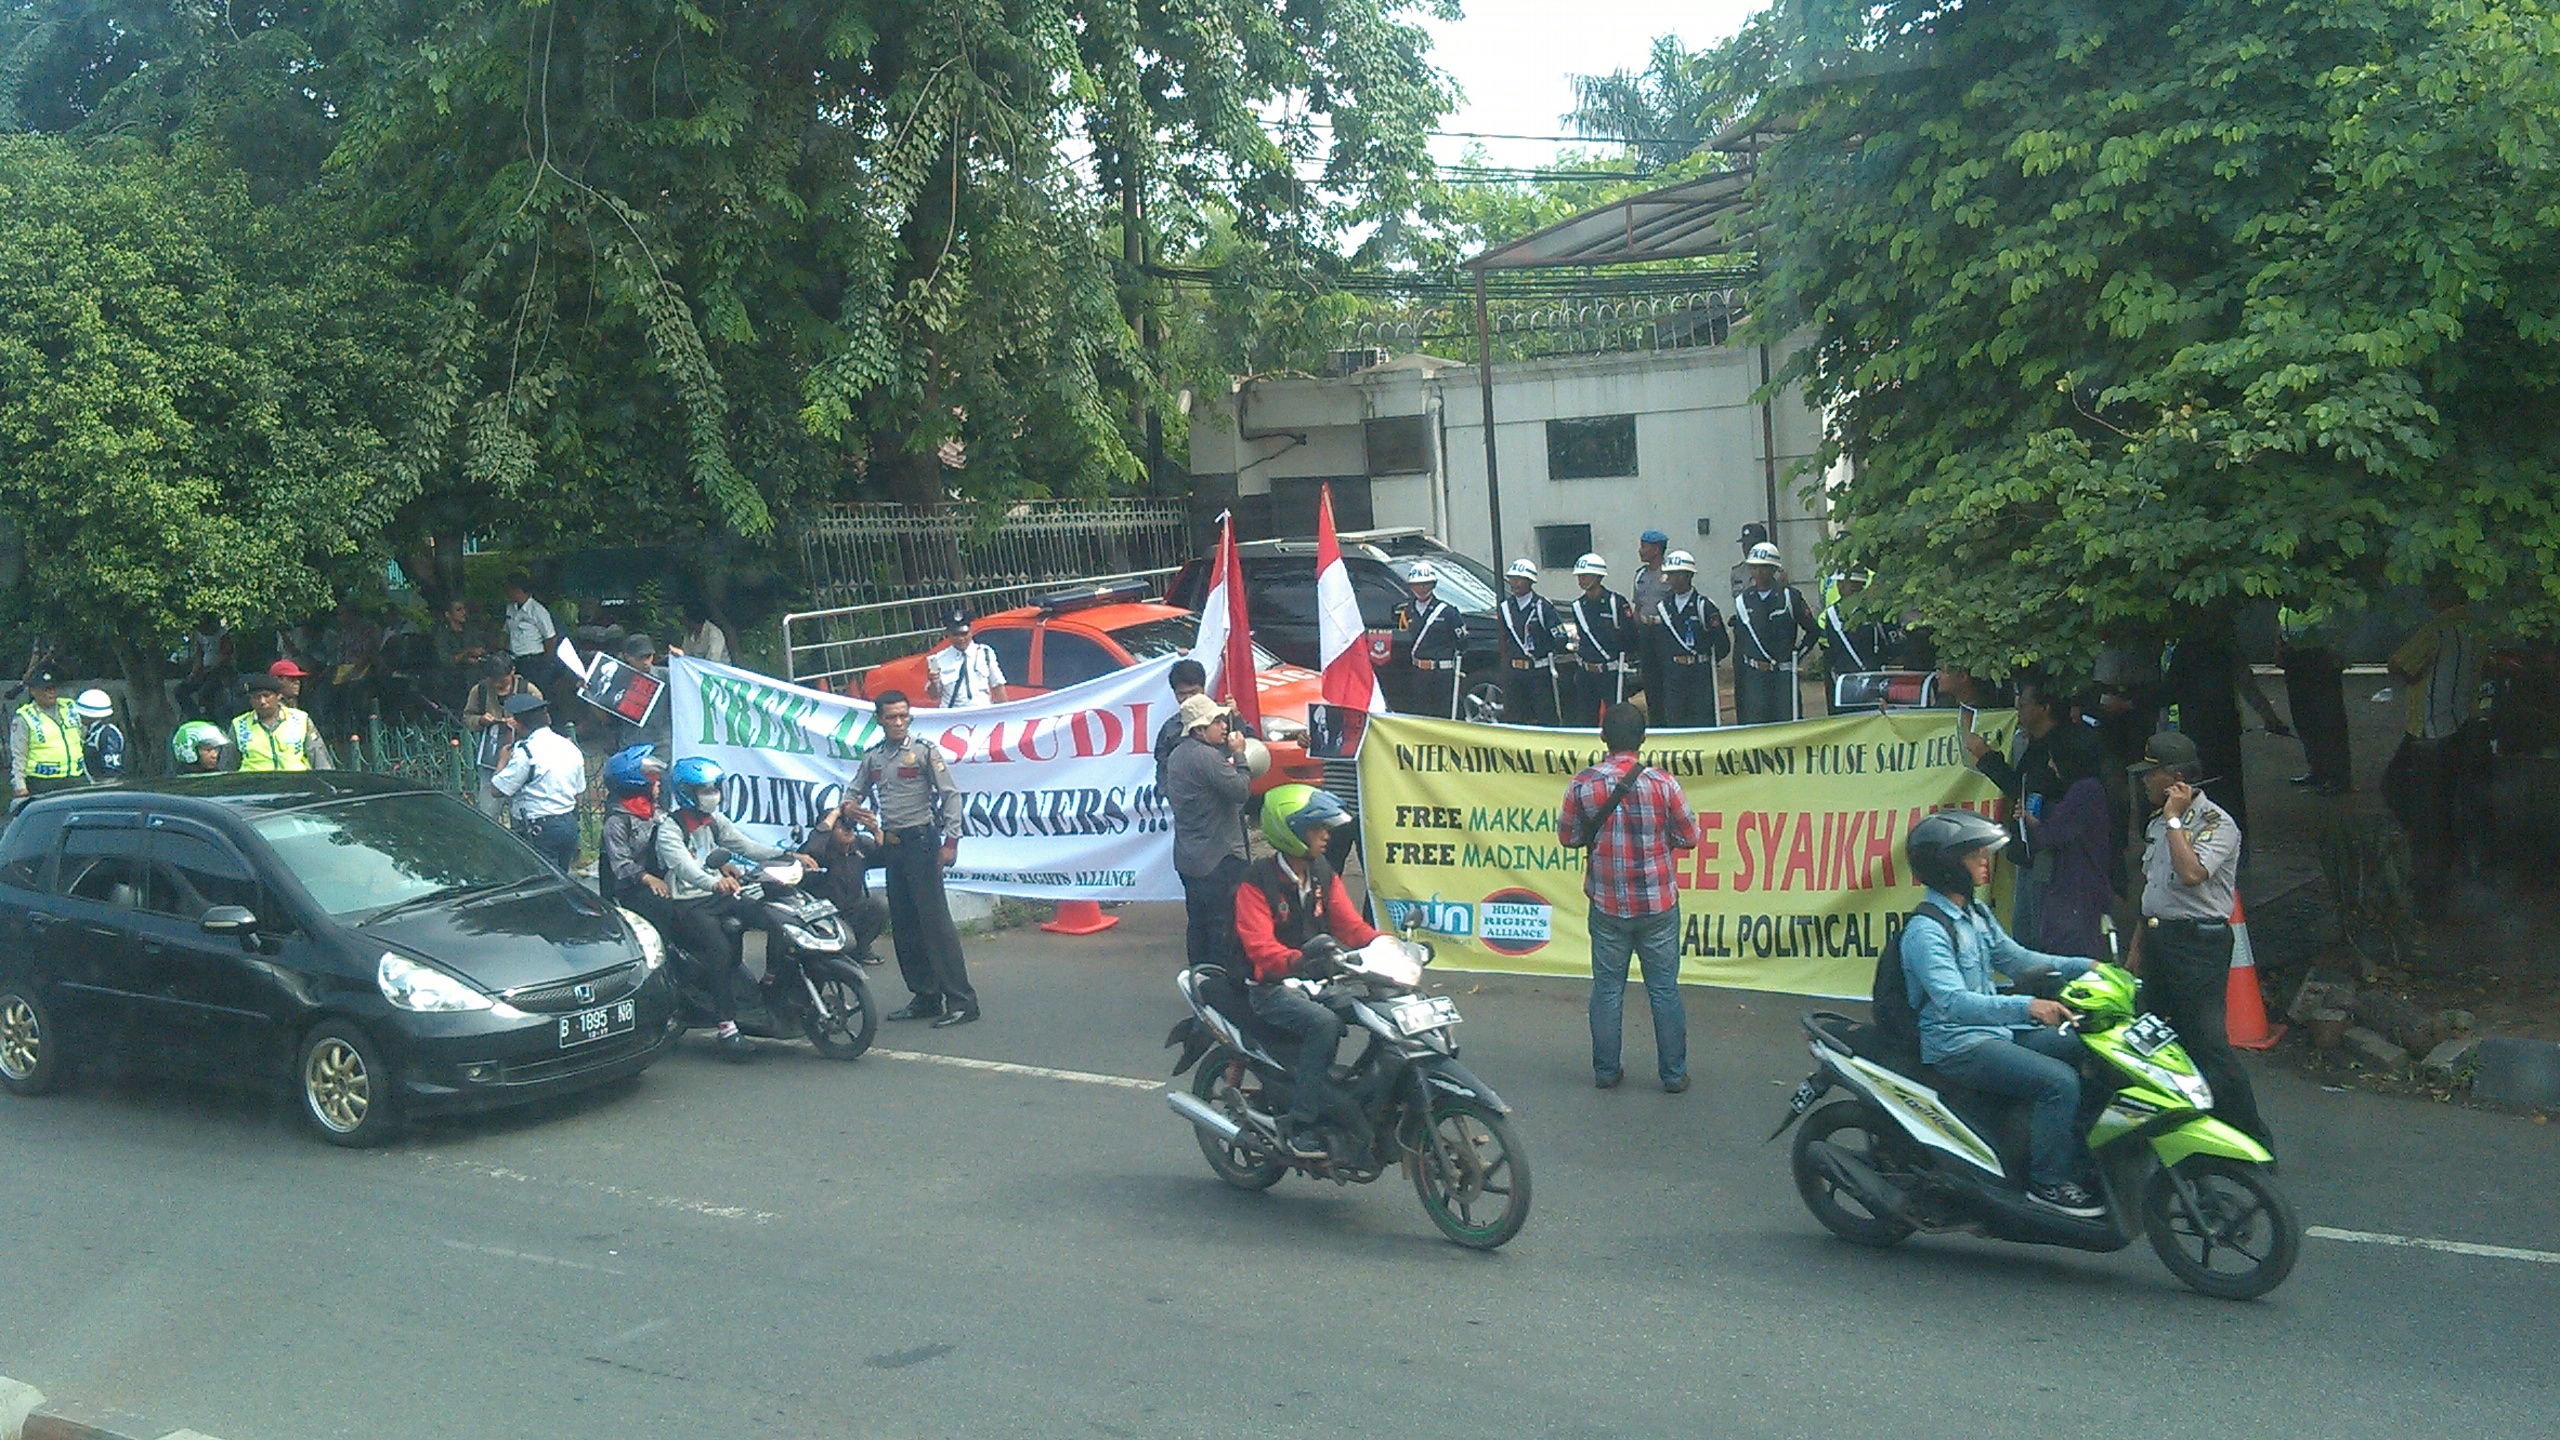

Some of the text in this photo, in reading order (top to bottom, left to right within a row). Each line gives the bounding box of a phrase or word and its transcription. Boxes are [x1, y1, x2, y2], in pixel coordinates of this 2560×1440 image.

[699, 671, 821, 755] FREE
[939, 702, 1155, 765] SAUDI
[1395, 743, 1539, 774] INTERNATIONAL
[1545, 749, 1581, 775] DAY
[1714, 746, 1797, 776] AGAINST
[1806, 743, 1868, 775] HOUSE
[1875, 742, 1920, 774] SAUD
[1395, 805, 1462, 829] FREE
[1386, 842, 1579, 872] FREE MADINAH
[1733, 808, 1897, 893] SYAIKH
[1017, 872, 1072, 886] RIGHTS
[1075, 870, 1136, 887] ALLIANCE
[1484, 916, 1548, 928] RIGHTS
[1491, 905, 1540, 916] HUMAN
[1486, 928, 1545, 939] ALLIANCE
[1680, 913, 1731, 957] ALL
[1737, 912, 1879, 958] POLITICAL
[561, 1019, 570, 1038] B
[579, 1008, 609, 1032] 1895
